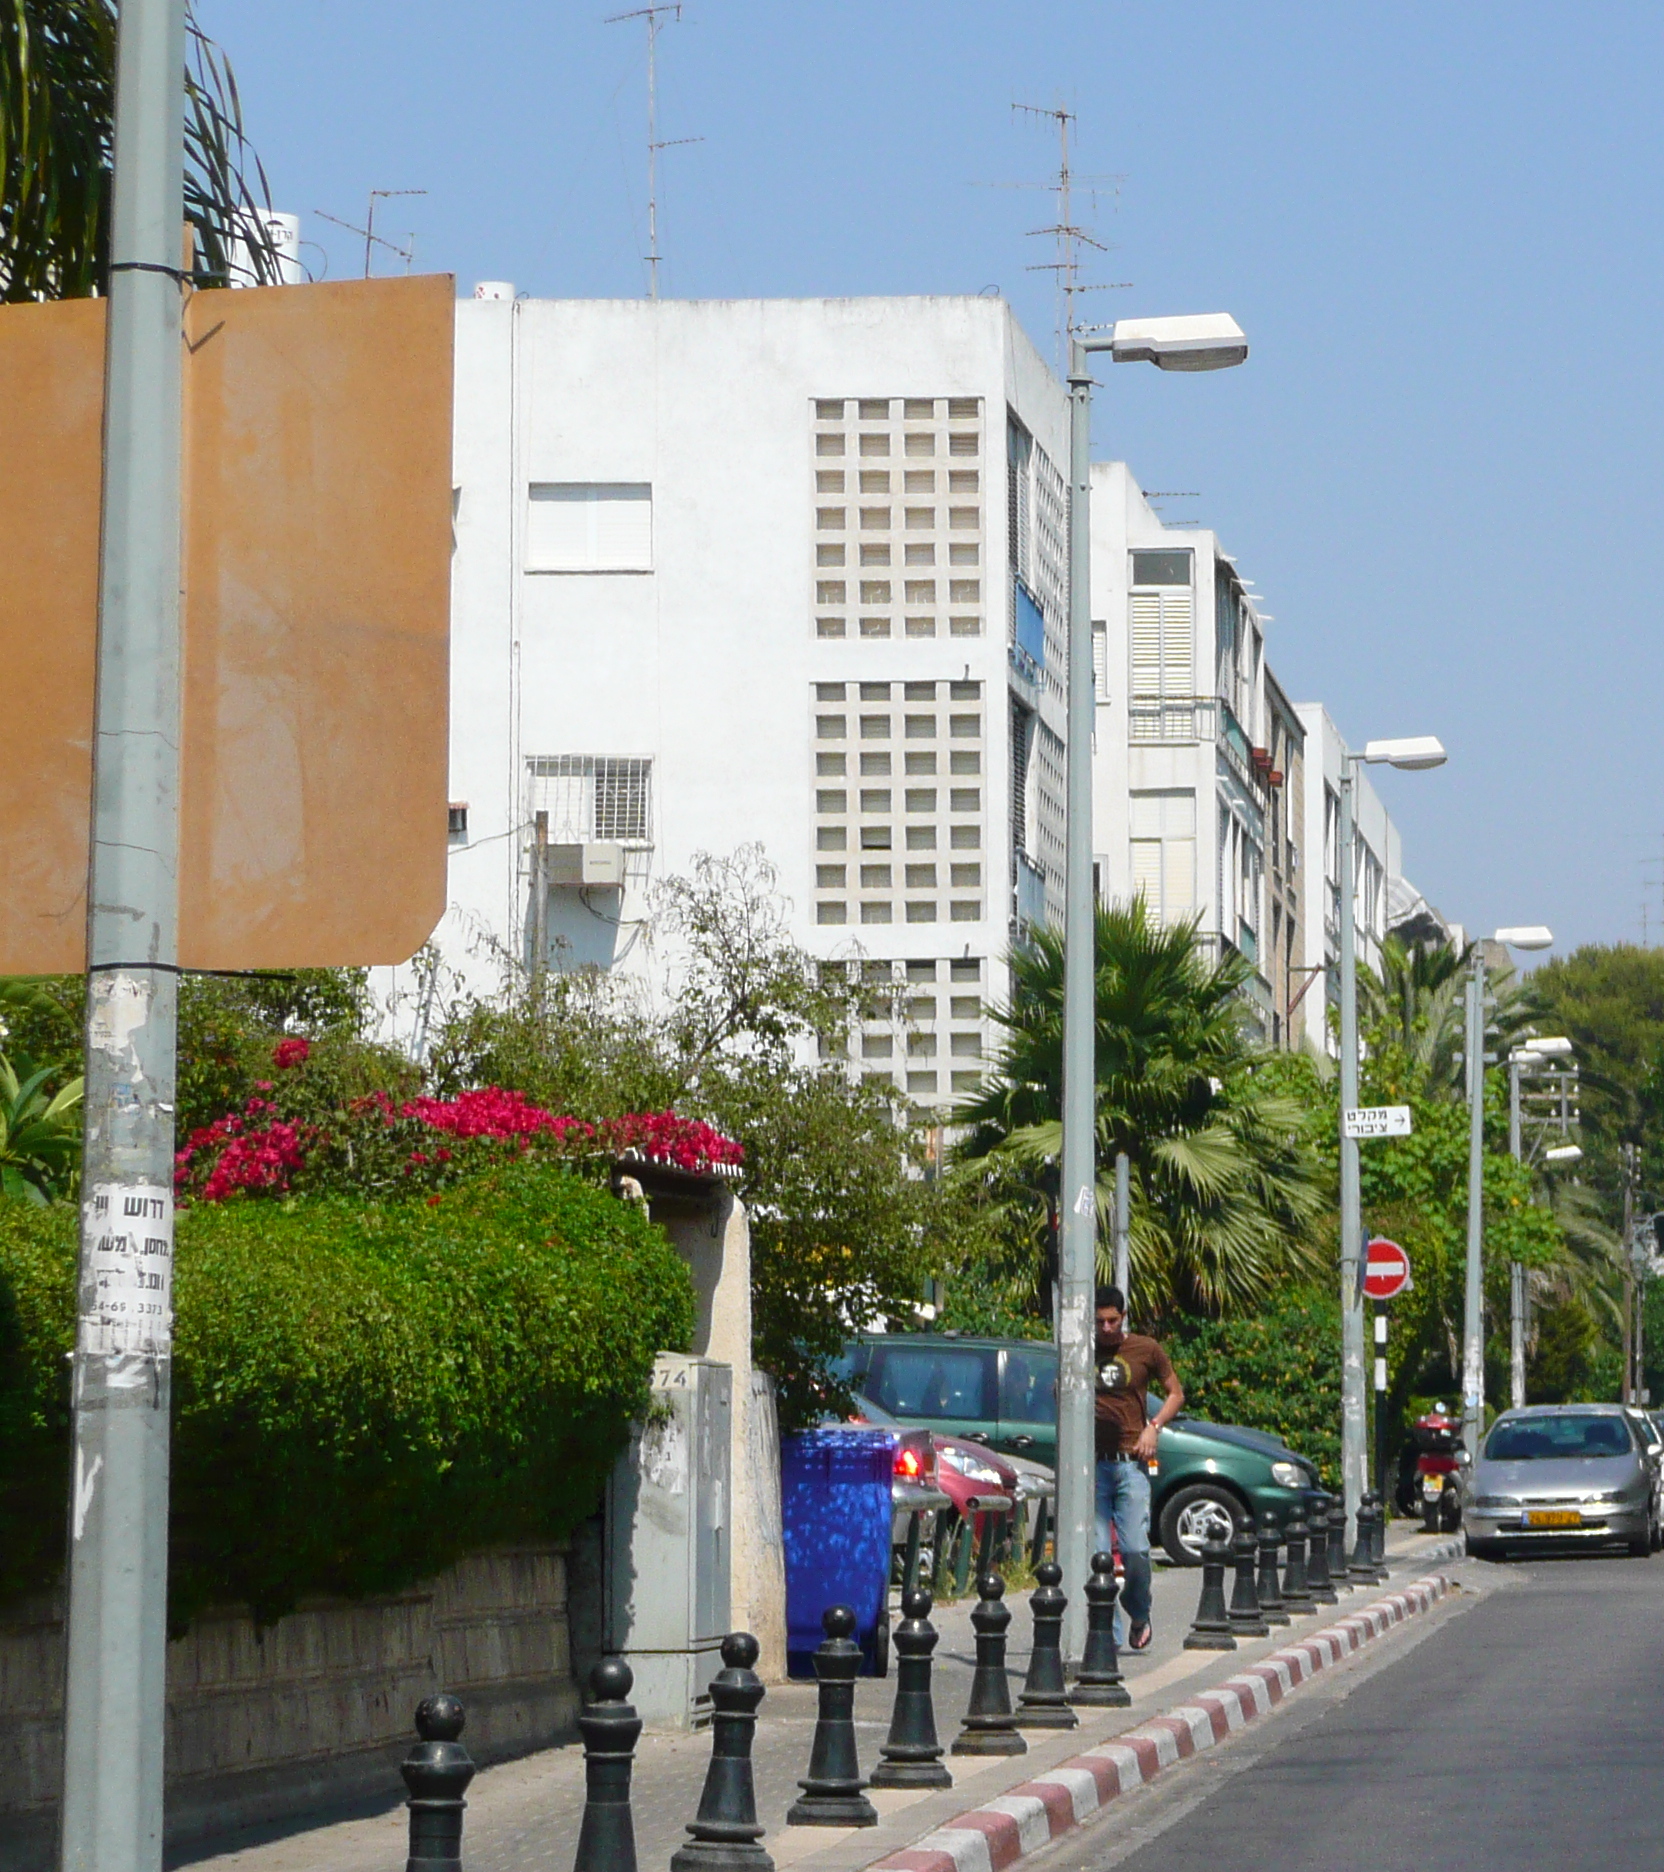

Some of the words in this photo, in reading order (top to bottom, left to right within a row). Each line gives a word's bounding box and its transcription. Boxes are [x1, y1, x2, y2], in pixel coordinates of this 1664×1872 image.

[1347, 1109, 1388, 1122] מקלט
[1347, 1123, 1388, 1134] ציבורי
[123, 1196, 165, 1219] דרוש
